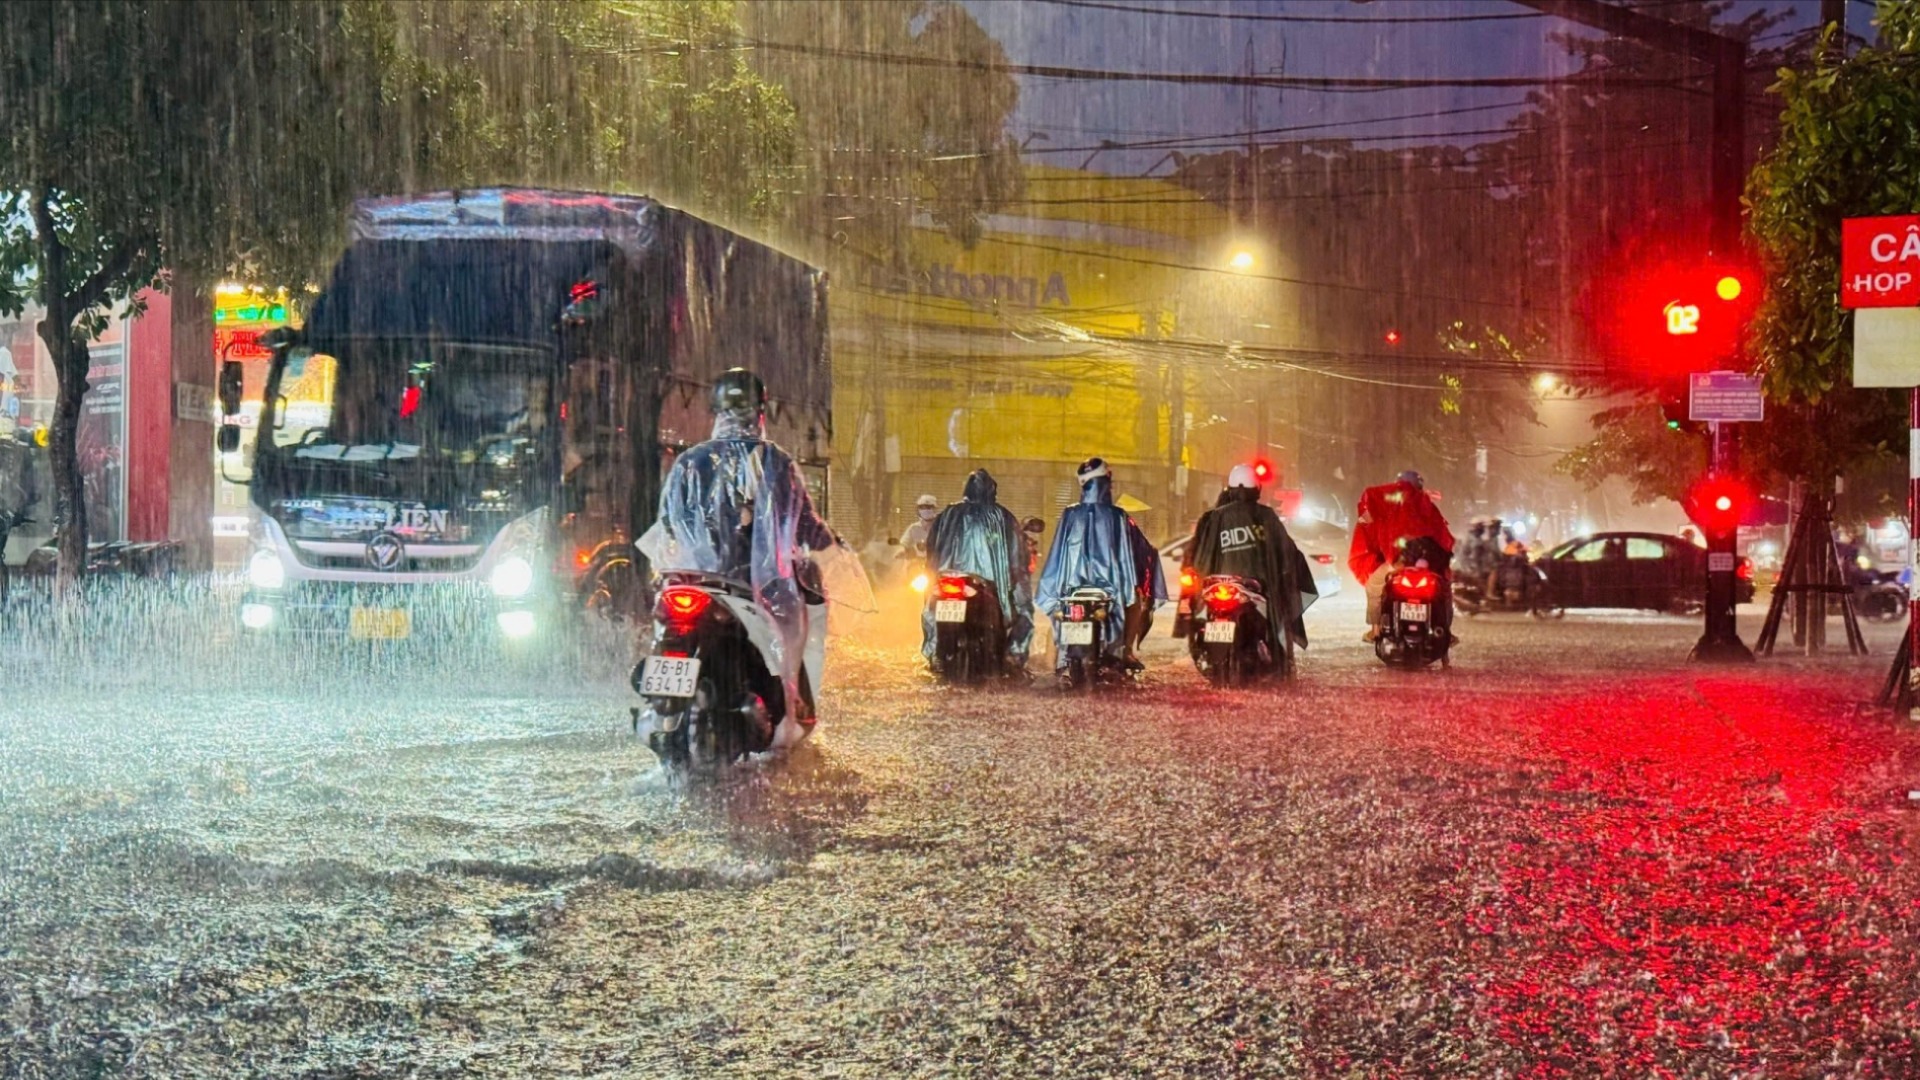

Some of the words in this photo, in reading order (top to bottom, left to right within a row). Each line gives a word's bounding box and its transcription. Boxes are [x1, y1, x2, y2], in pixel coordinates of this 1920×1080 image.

[1666, 304, 1700, 335] 02
[653, 660, 690, 676] 76-B1
[645, 676, 693, 694] 634.13
